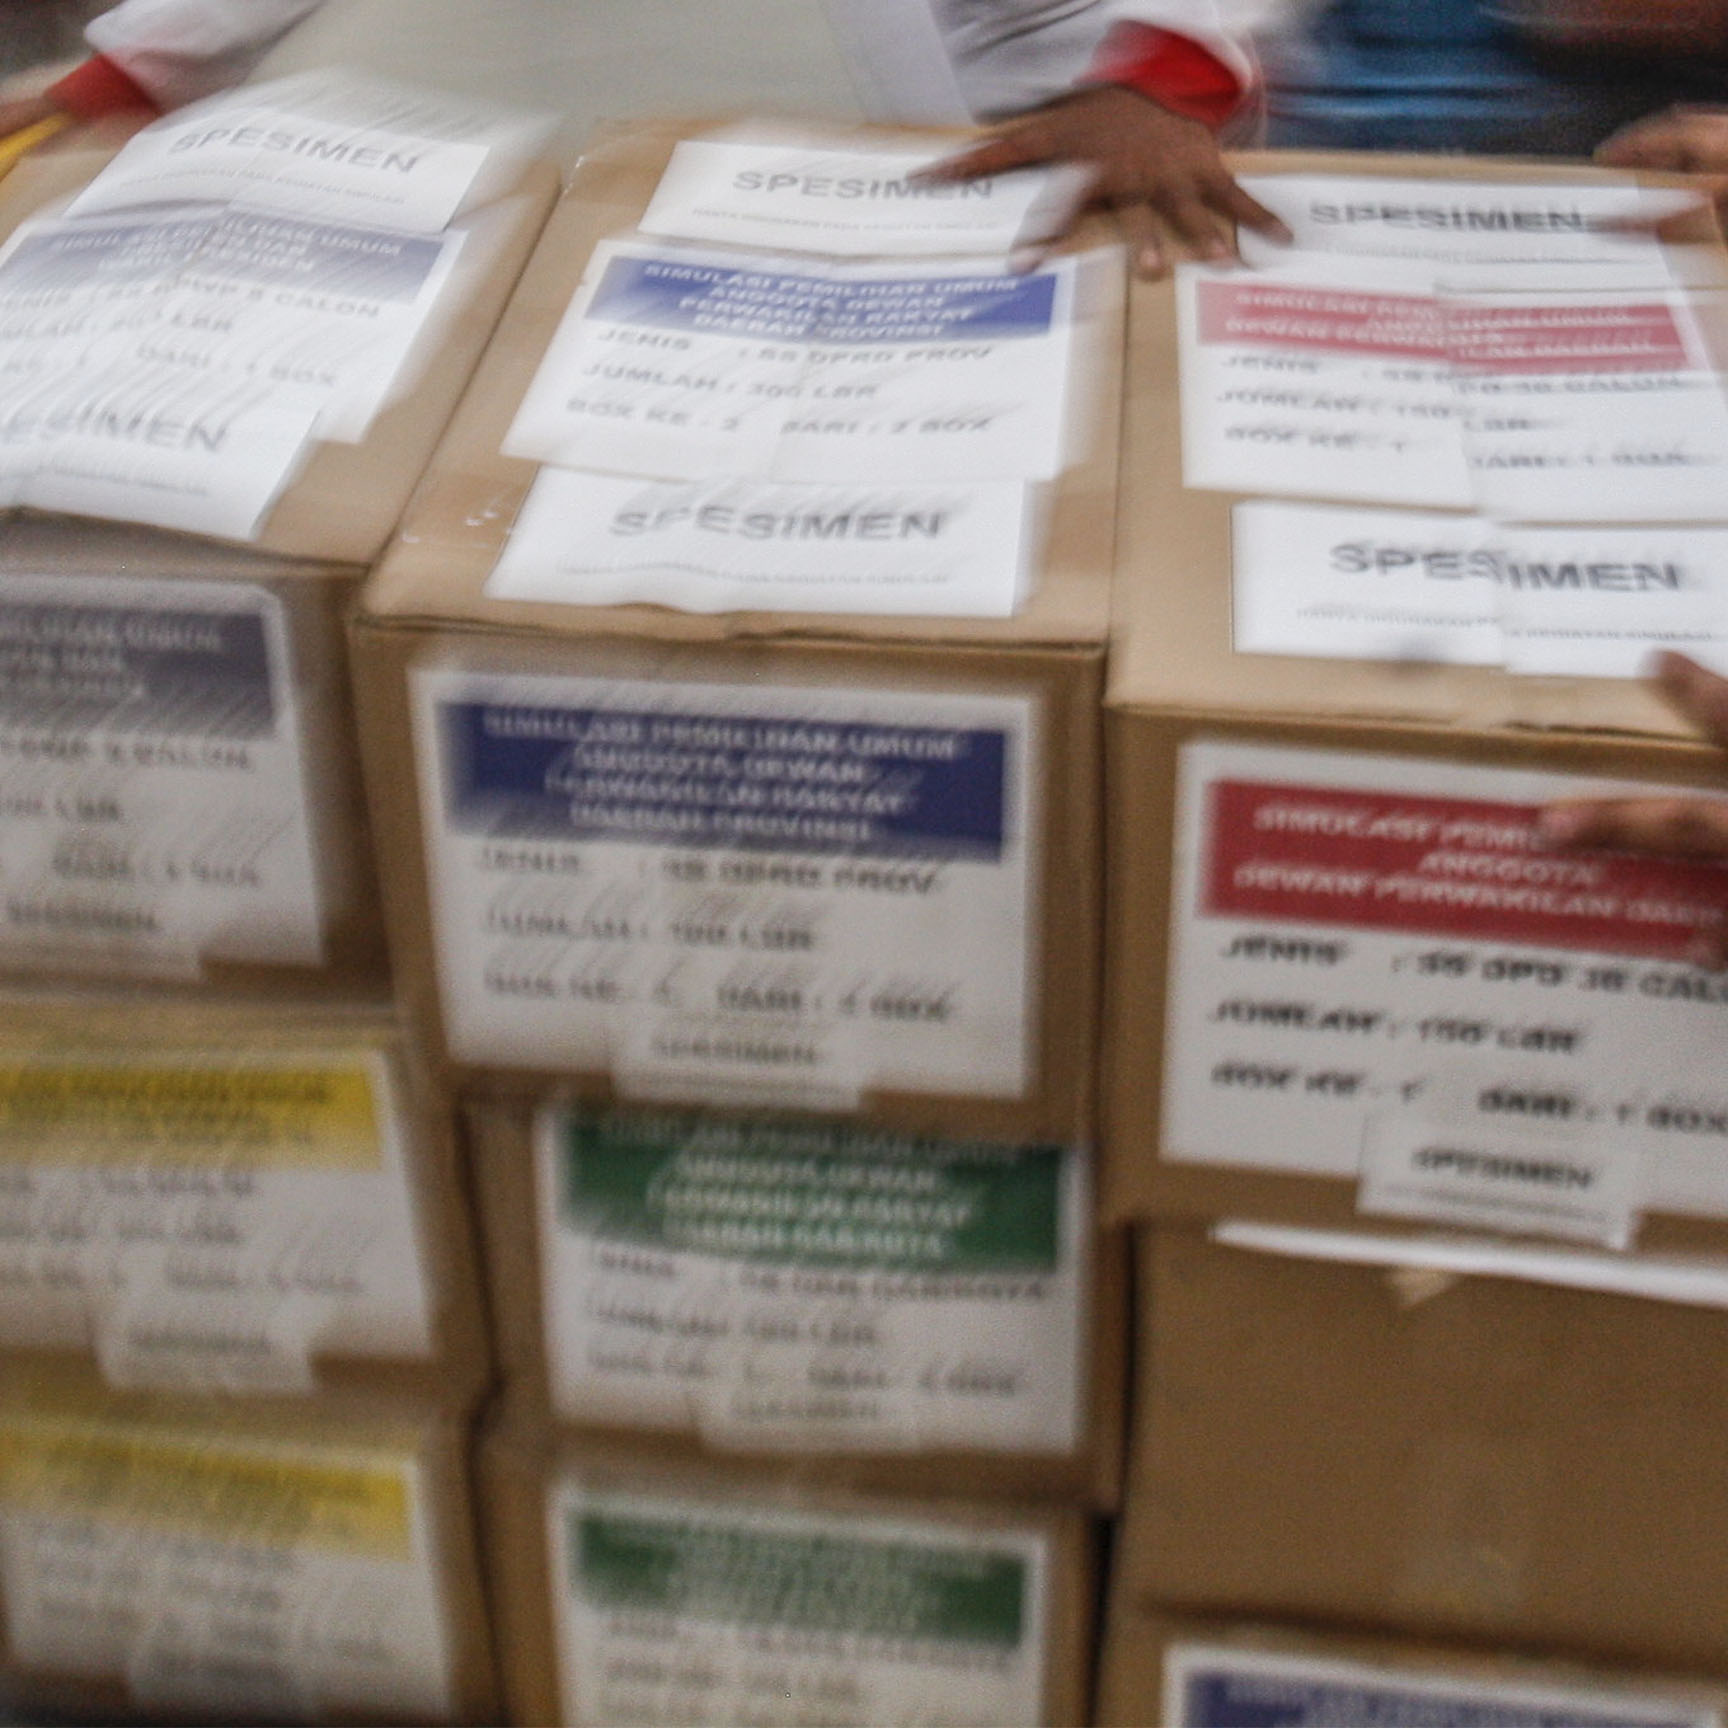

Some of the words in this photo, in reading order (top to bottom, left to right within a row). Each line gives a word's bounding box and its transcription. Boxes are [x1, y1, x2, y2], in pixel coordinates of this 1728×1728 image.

[170, 124, 419, 173] SPESIMEN
[1309, 201, 1585, 234] SPESIMEN
[594, 327, 692, 352] JENIS
[583, 364, 720, 392] JUMLAH
[608, 501, 947, 541] SPESIMEN
[1329, 541, 1684, 592] SPESIMEN
[1253, 806, 1432, 843] SIMULASI
[1234, 859, 1369, 899] DEWAN
[1220, 932, 1346, 965] JENIS
[1210, 998, 1382, 1034] JUMLAH
[1410, 1144, 1594, 1191] SPESIMEN
